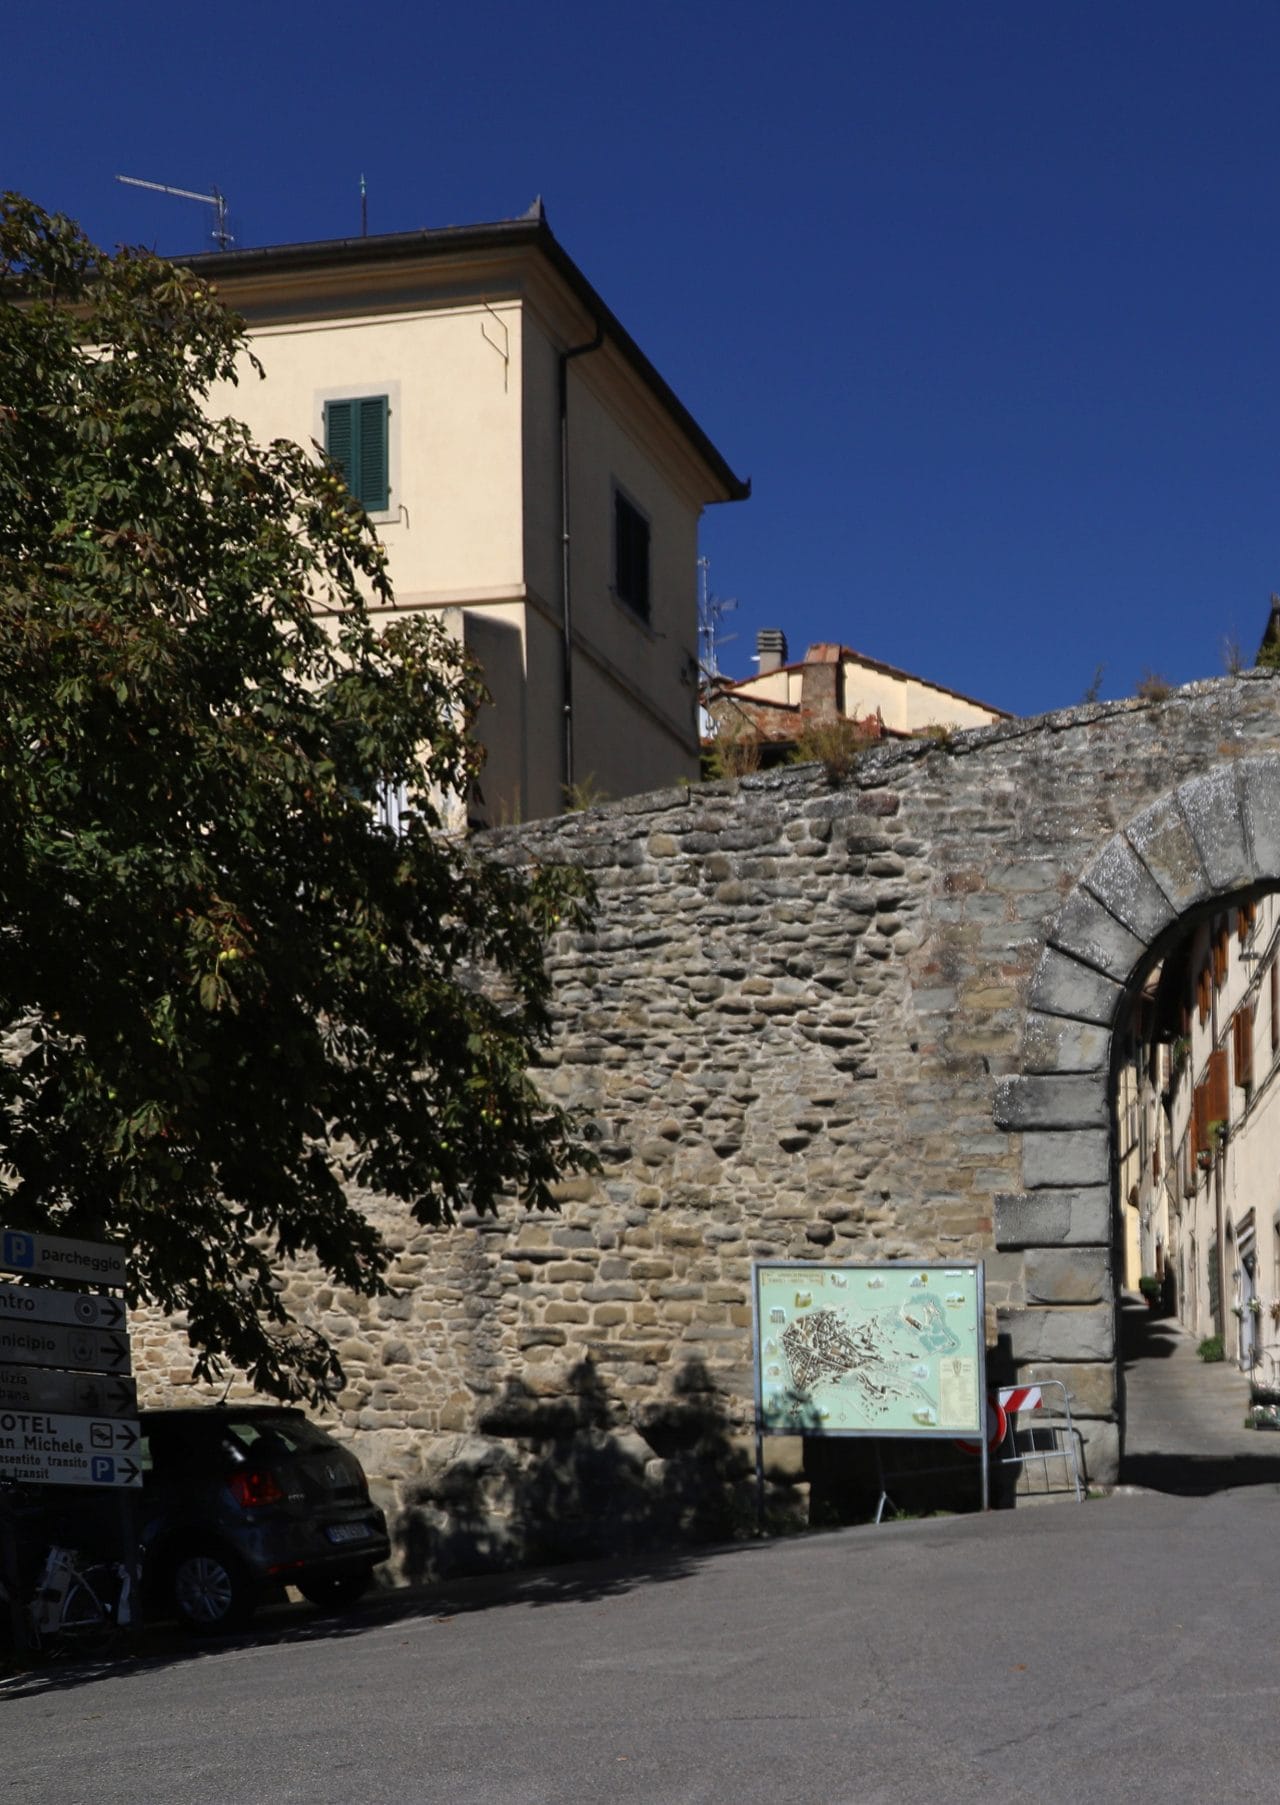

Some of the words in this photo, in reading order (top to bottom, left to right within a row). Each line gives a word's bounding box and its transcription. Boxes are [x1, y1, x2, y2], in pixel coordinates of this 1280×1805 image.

[42, 1248, 121, 1273] parcheggio
[0, 1413, 58, 1435] OTEL
[24, 1436, 84, 1453] Michele
[48, 1455, 88, 1468] transito
[14, 1466, 49, 1480] transit
